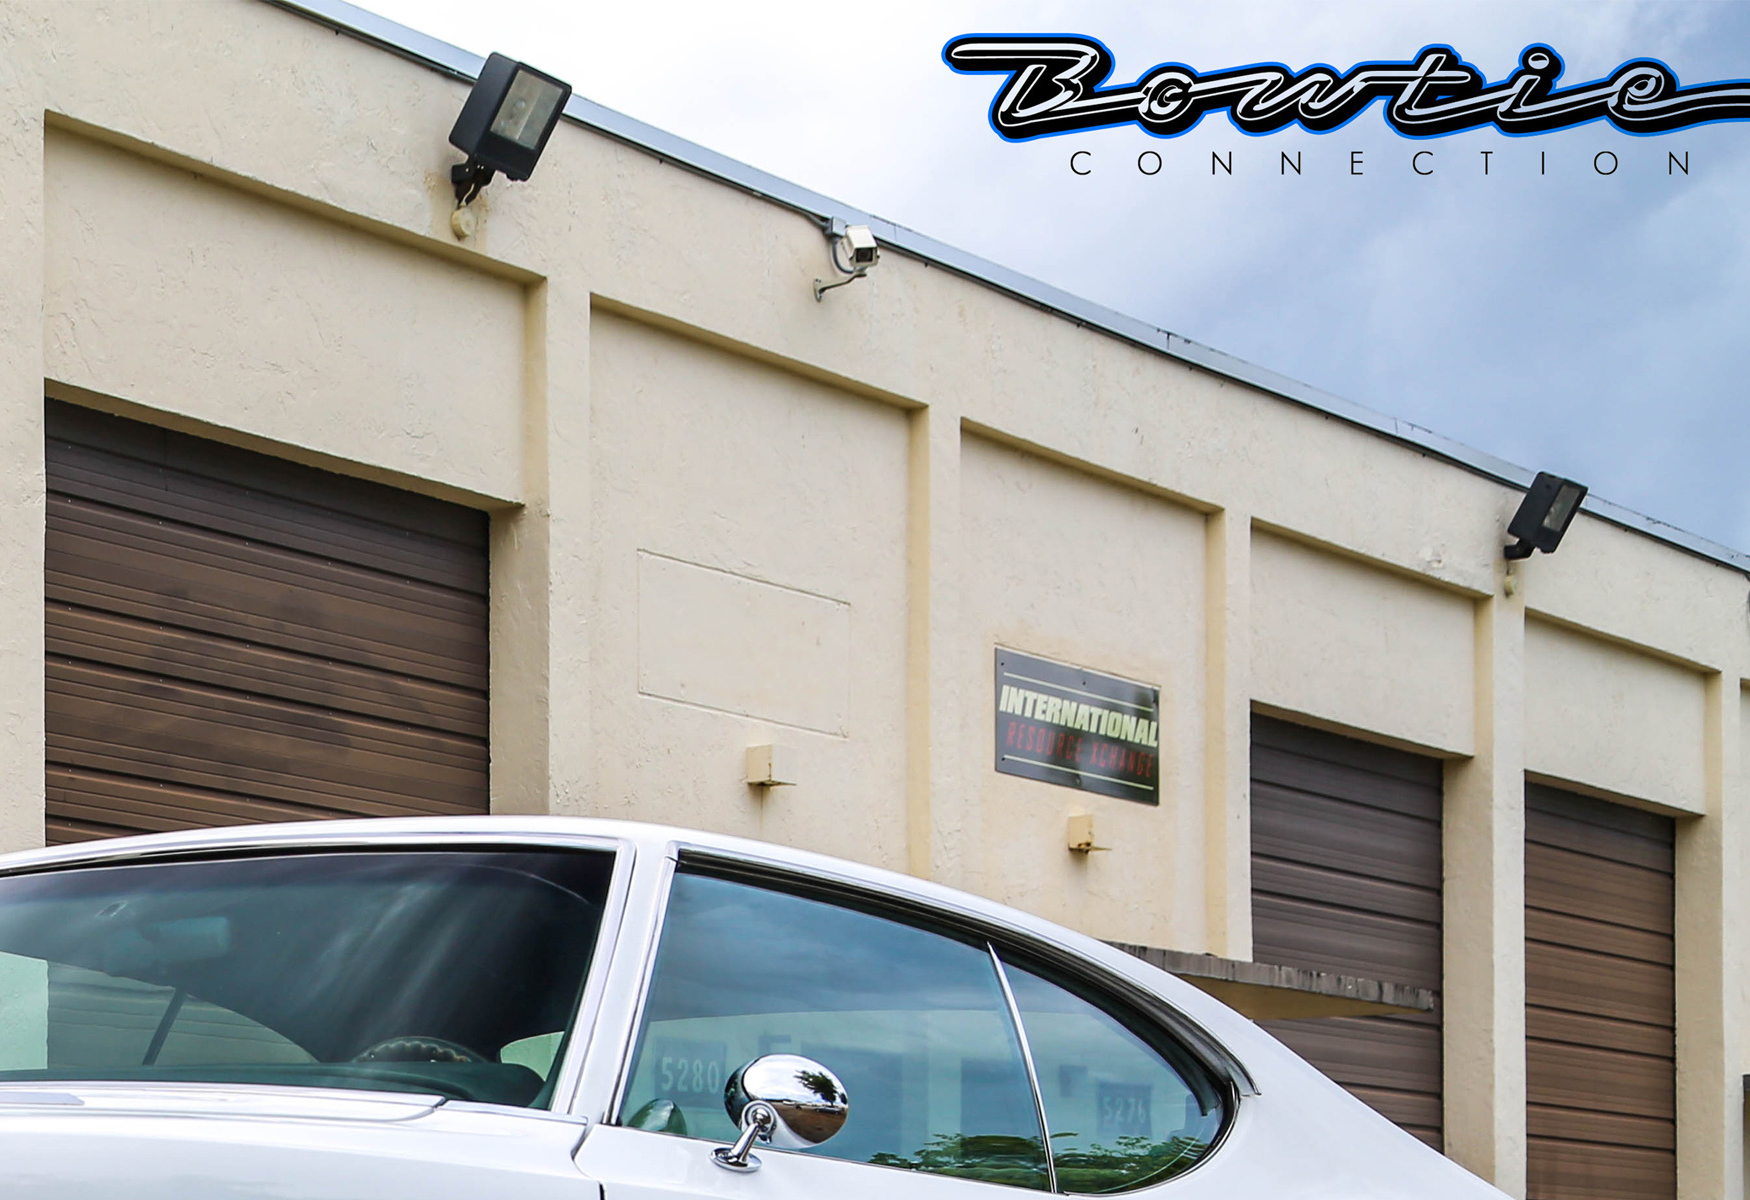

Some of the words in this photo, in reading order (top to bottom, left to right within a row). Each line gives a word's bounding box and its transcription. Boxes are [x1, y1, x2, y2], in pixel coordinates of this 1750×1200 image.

[999, 684, 1158, 748] INTERNATIONAL
[1007, 721, 1084, 763] RESOURCE
[1089, 741, 1155, 778] XCHANGE
[661, 1057, 720, 1095] 5280
